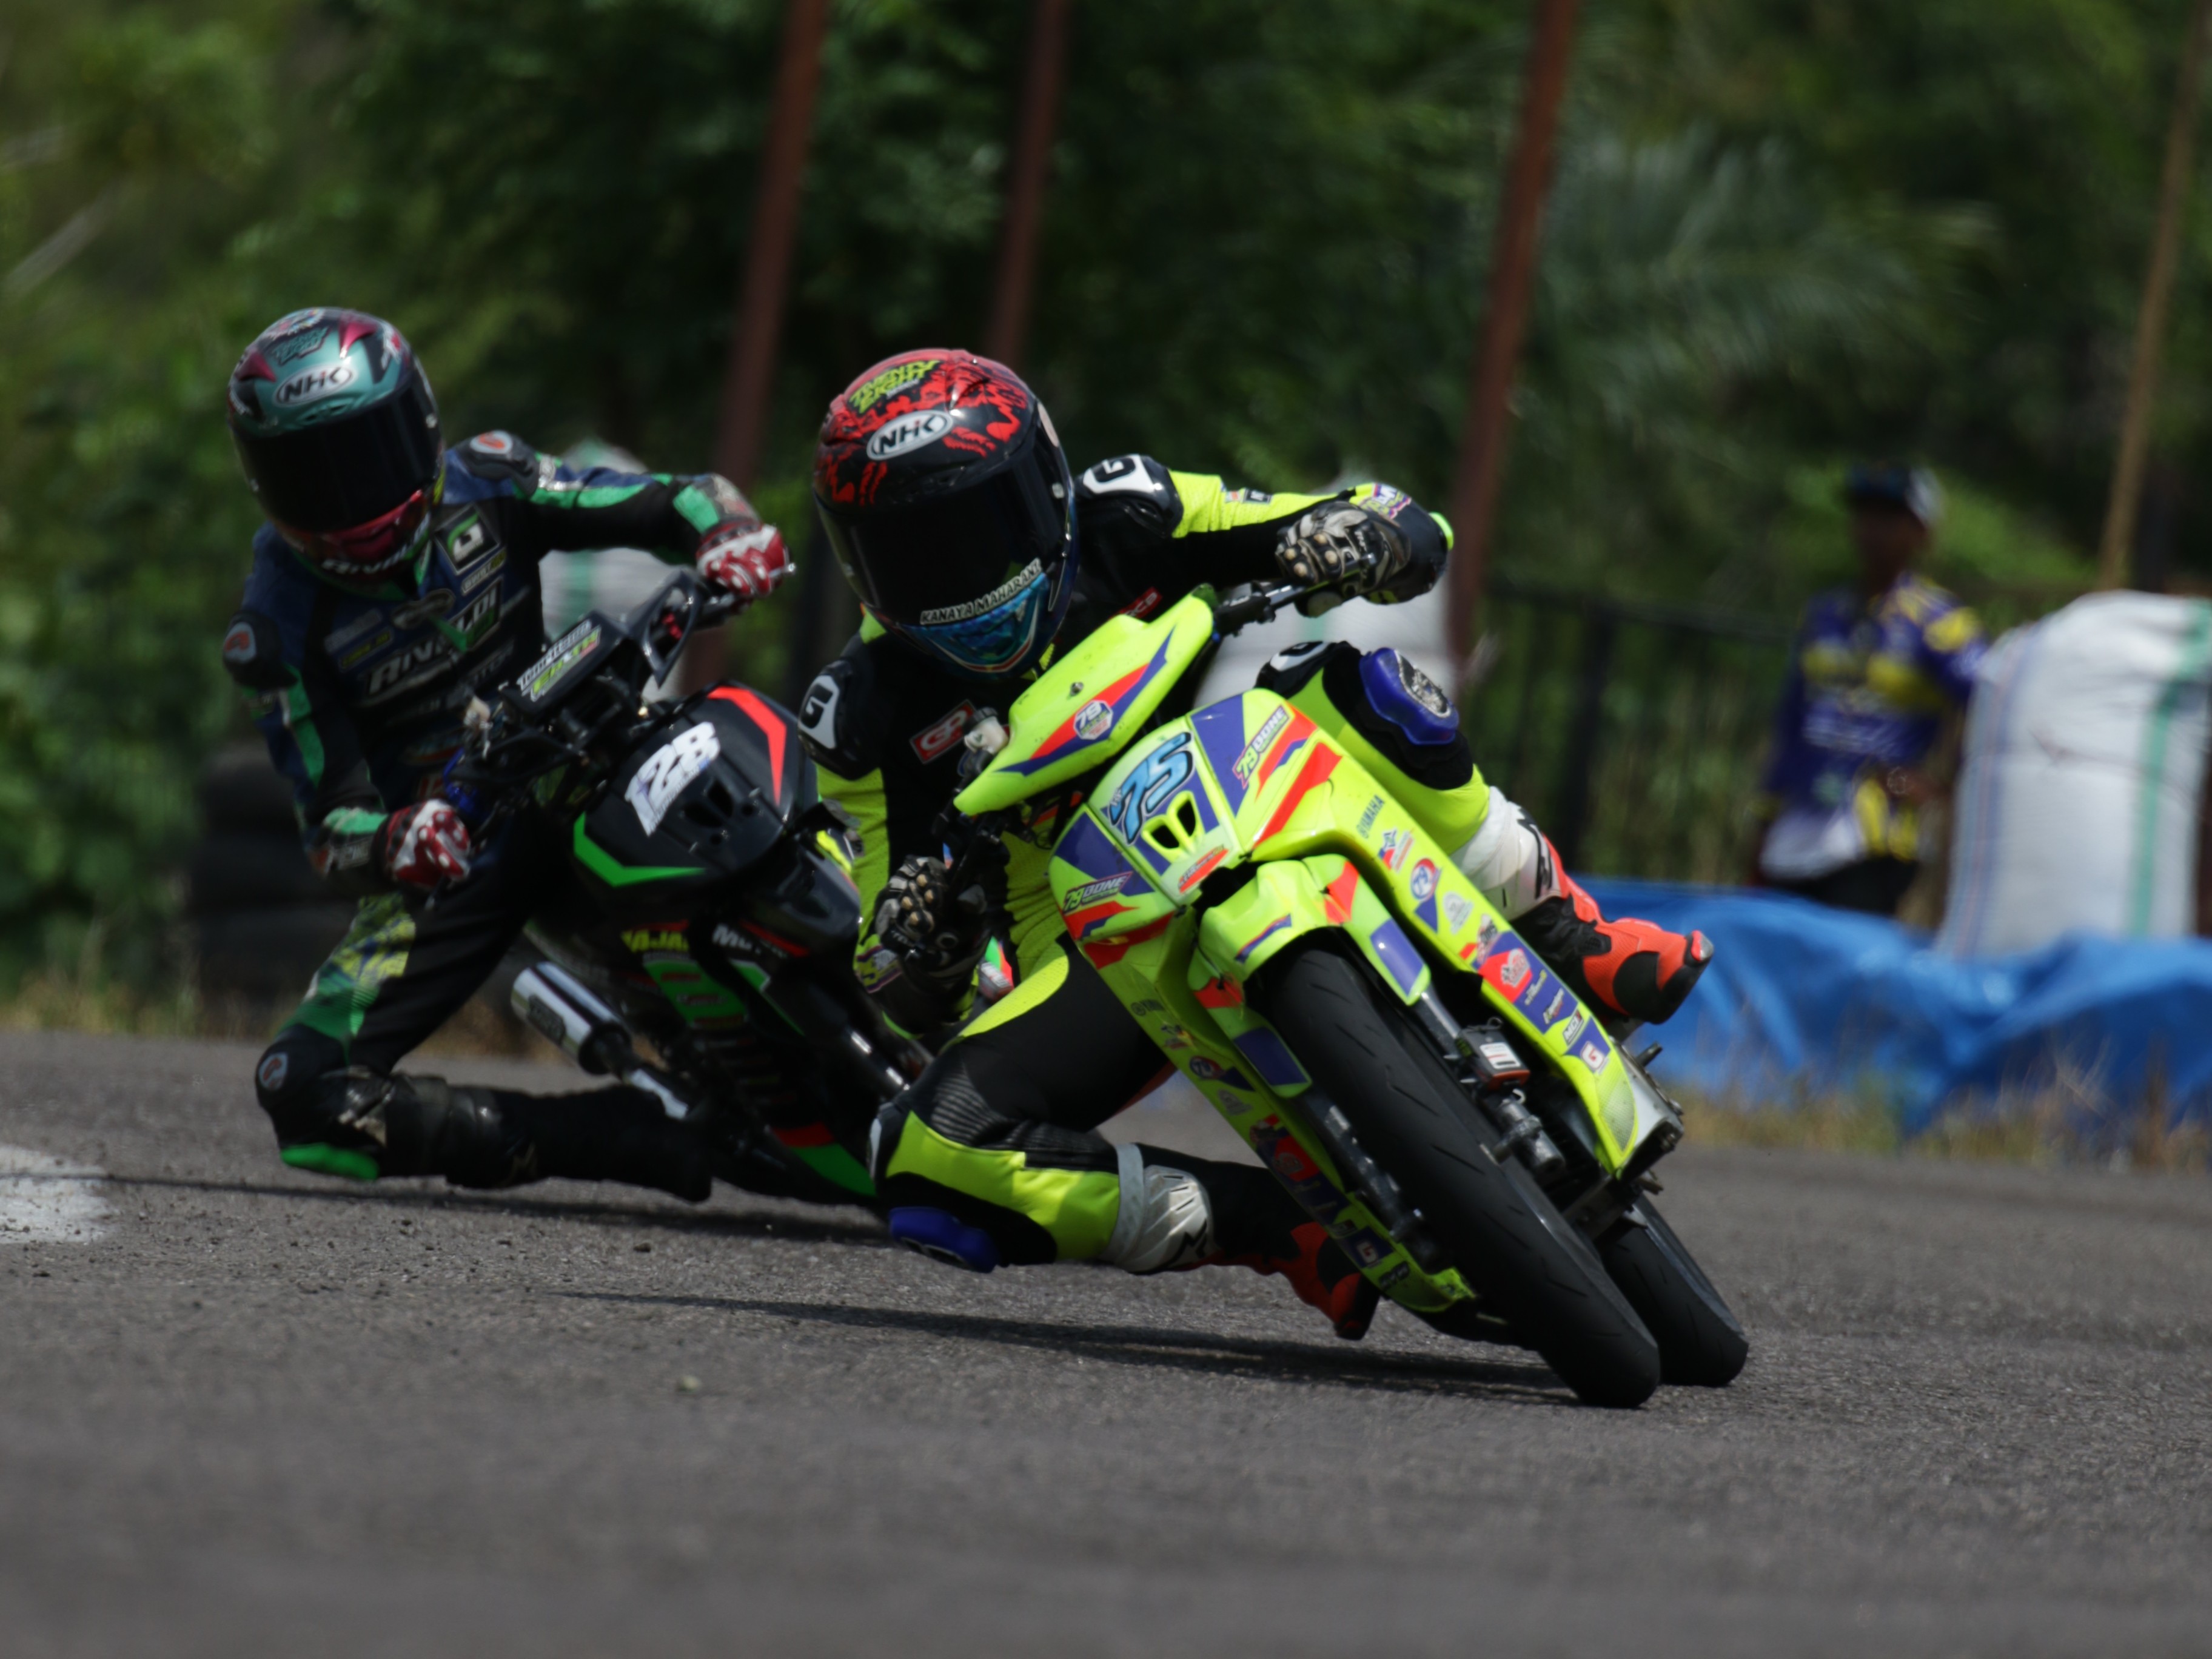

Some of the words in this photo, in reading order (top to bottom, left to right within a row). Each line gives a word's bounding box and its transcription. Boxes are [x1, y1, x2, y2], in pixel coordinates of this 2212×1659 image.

[283, 367, 343, 398] NHK
[877, 416, 938, 455] NHK
[1108, 731, 1193, 844] 75
[1364, 794, 1385, 830] YAMAHA
